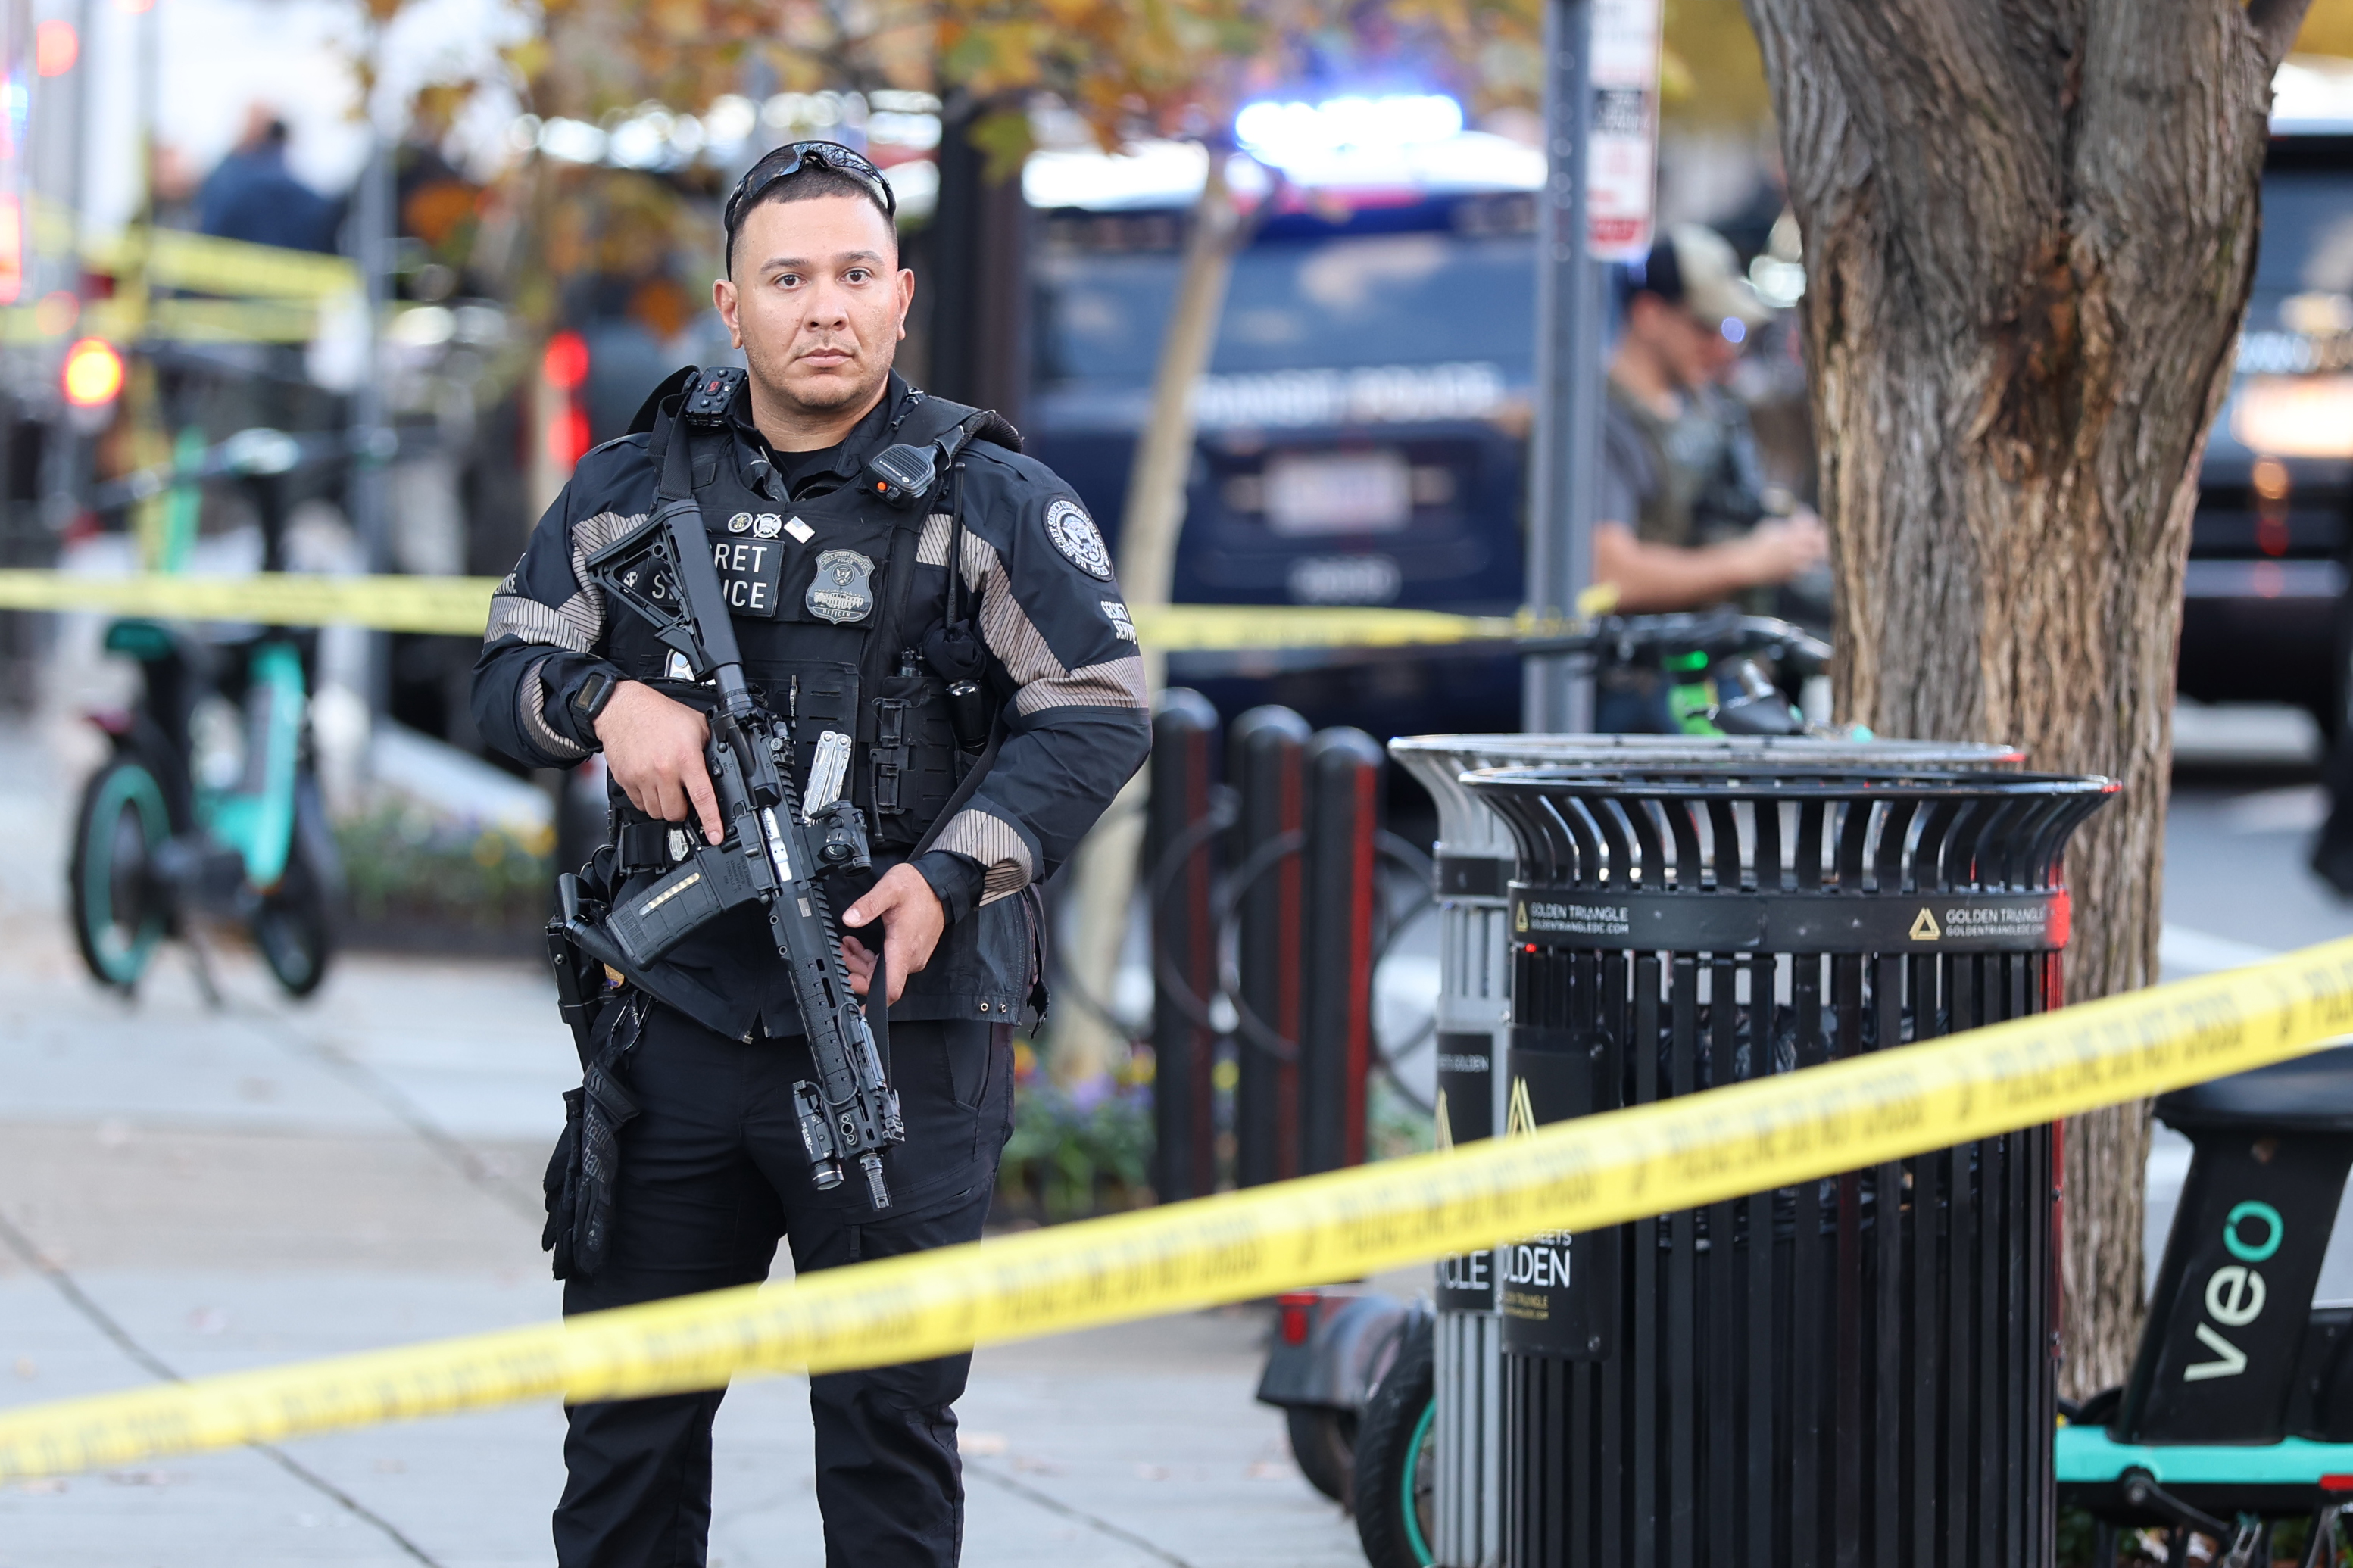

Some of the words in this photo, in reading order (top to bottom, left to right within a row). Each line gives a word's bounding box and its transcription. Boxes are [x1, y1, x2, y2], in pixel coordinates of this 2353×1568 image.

[822, 609, 851, 618] OFFICER
[1530, 902, 1567, 919] GOLDEN
[1568, 904, 1629, 922] TRIANGLE
[1946, 908, 1998, 924] GOLDEN
[2183, 1199, 2284, 1383] veo
